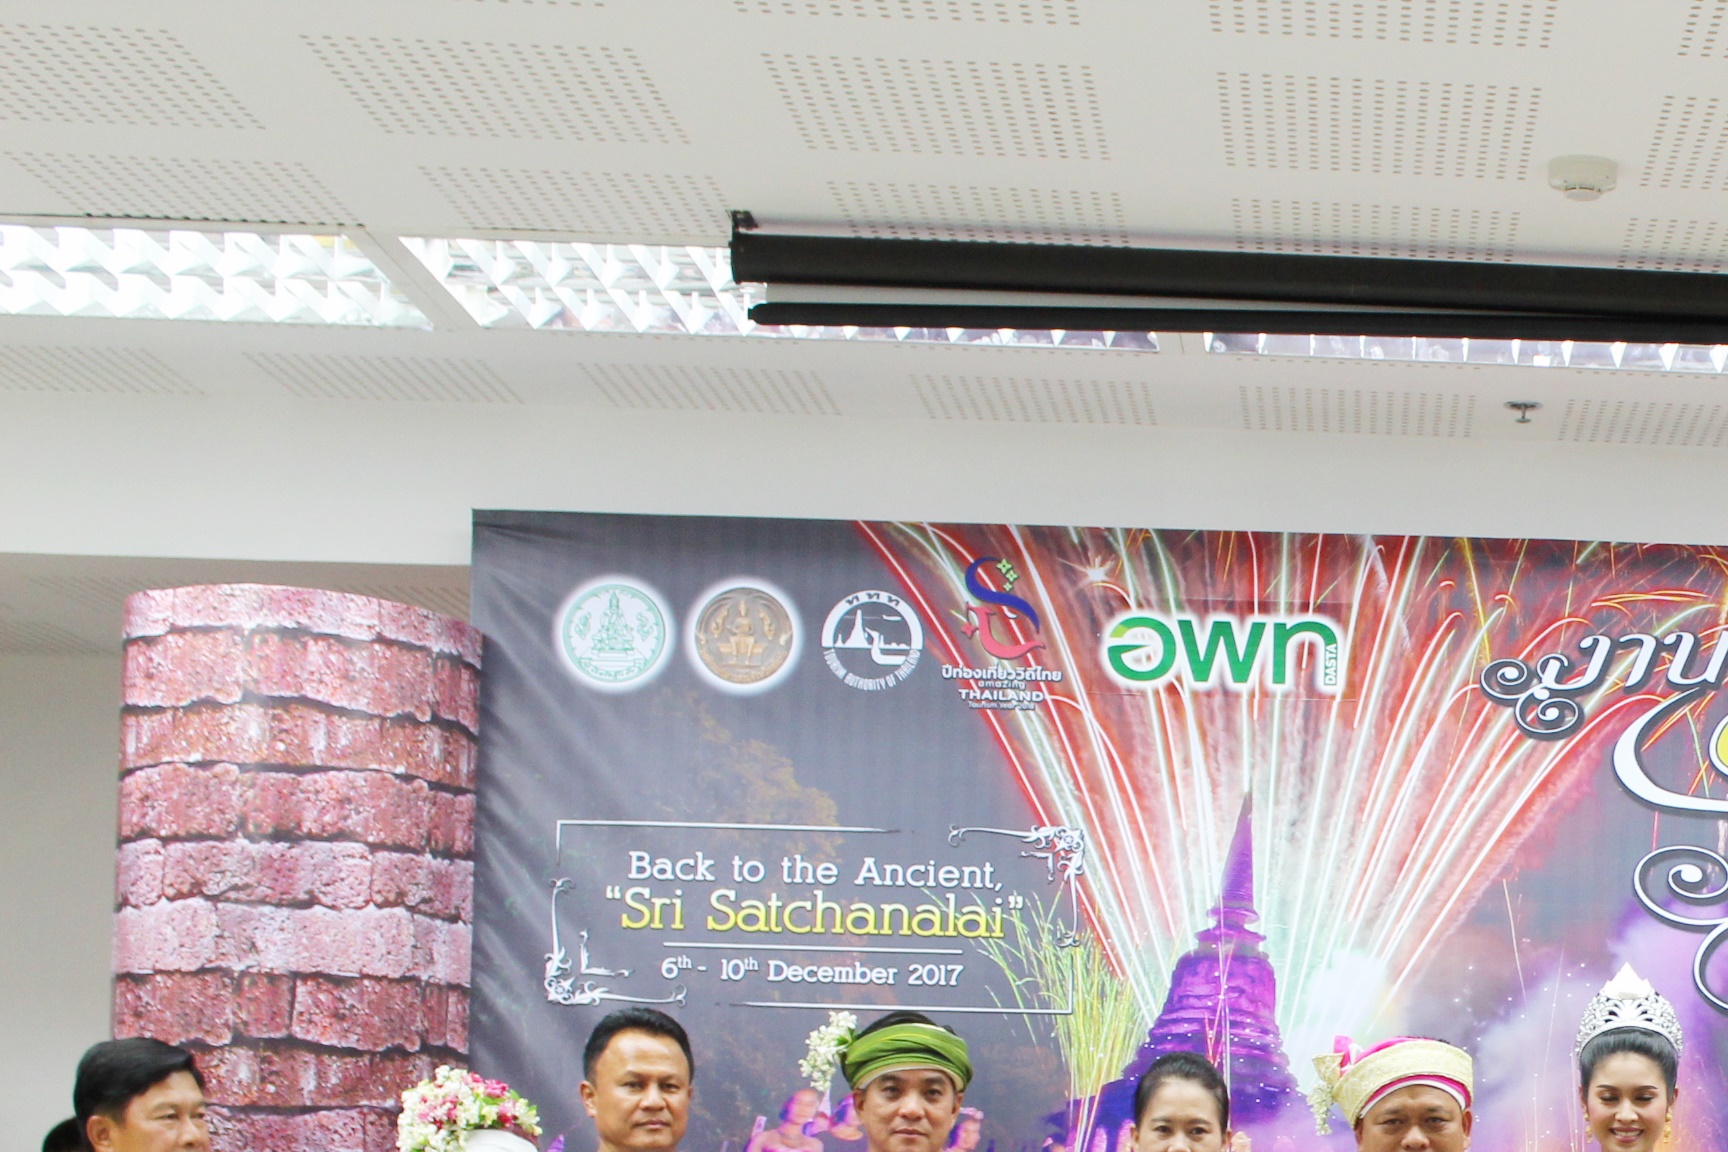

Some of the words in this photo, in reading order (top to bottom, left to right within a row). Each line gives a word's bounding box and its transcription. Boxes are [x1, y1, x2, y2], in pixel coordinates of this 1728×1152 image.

[1324, 643, 1338, 685] DASTA
[958, 688, 1045, 702] THAILAND
[977, 680, 1026, 690] amazing
[627, 850, 716, 882] Back
[732, 855, 766, 884] to
[781, 854, 838, 885] the
[854, 856, 1004, 891] Ancient,
[766, 959, 899, 986] December
[908, 963, 964, 987] 2017
